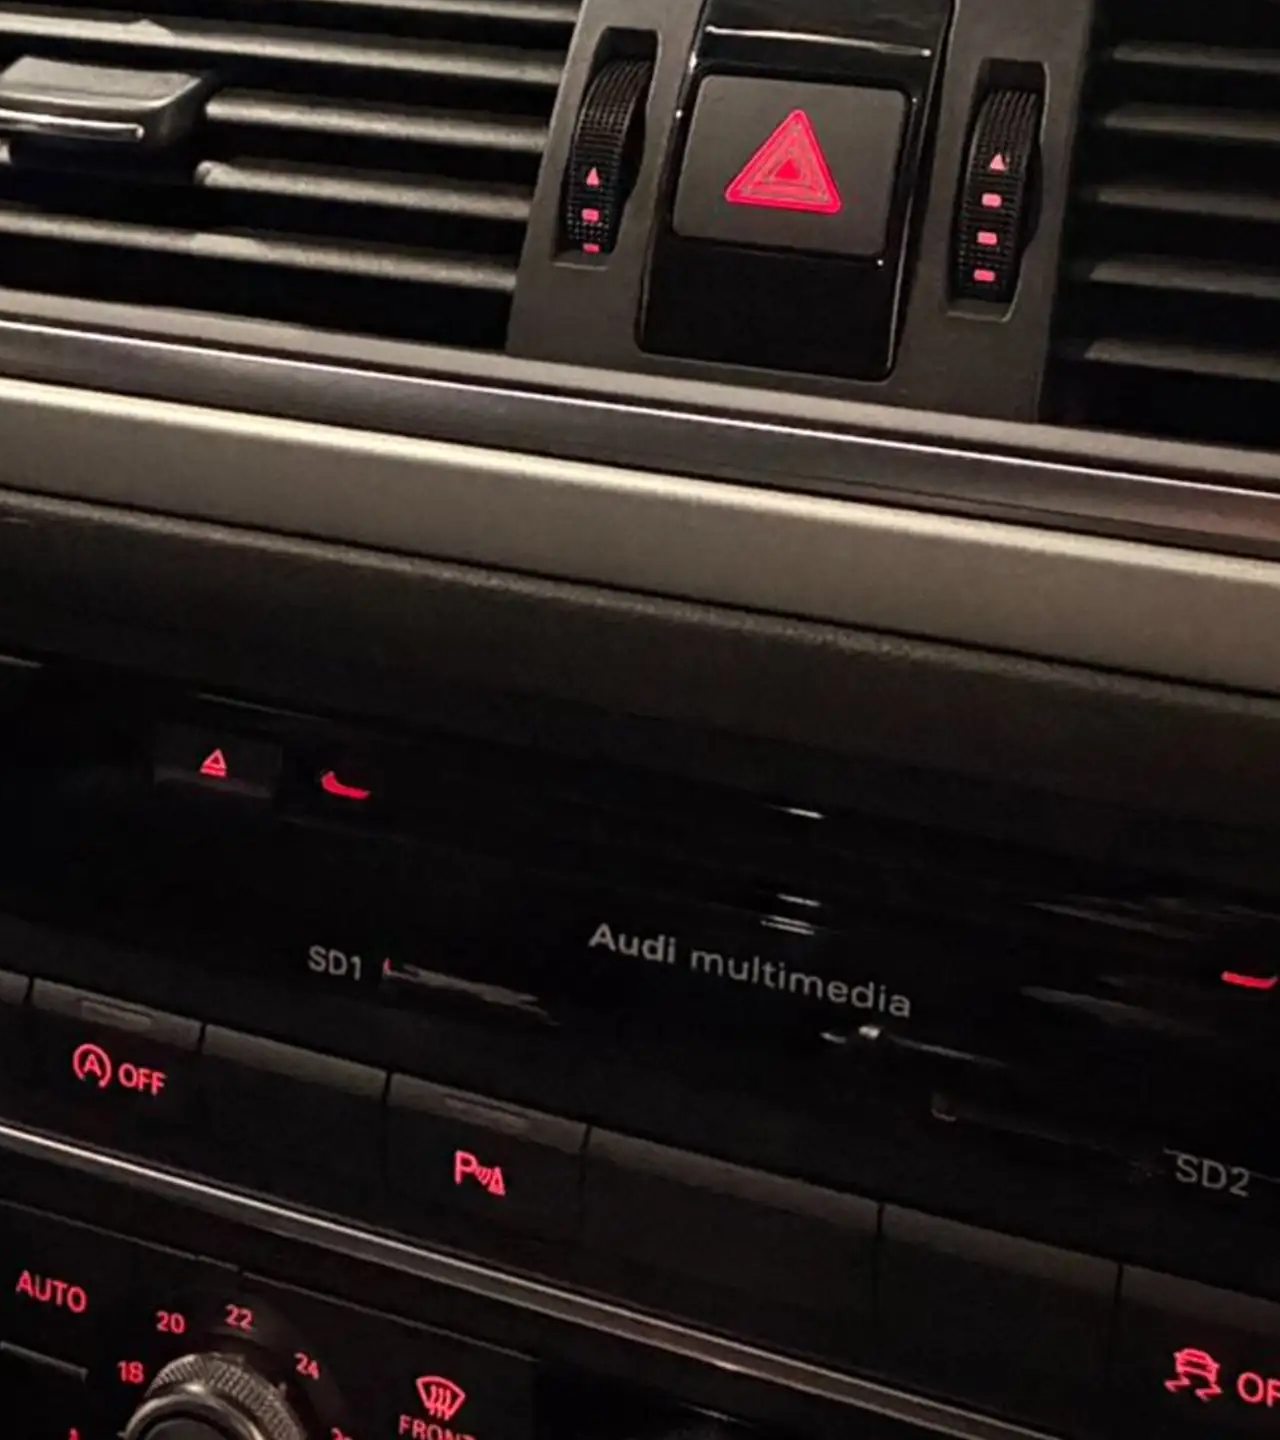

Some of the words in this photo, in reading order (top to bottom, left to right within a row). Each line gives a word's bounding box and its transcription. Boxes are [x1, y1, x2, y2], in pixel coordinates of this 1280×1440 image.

[310, 946, 360, 979] SD1
[589, 924, 676, 963] Audi
[692, 950, 911, 1019] multimedia
[119, 1063, 164, 1094] OFF
[1176, 1153, 1250, 1196] SD2
[17, 1271, 86, 1312] AUTO
[158, 1312, 185, 1333] 20
[226, 1305, 252, 1330] 22
[119, 1362, 144, 1383] 18
[296, 1353, 319, 1379] 24
